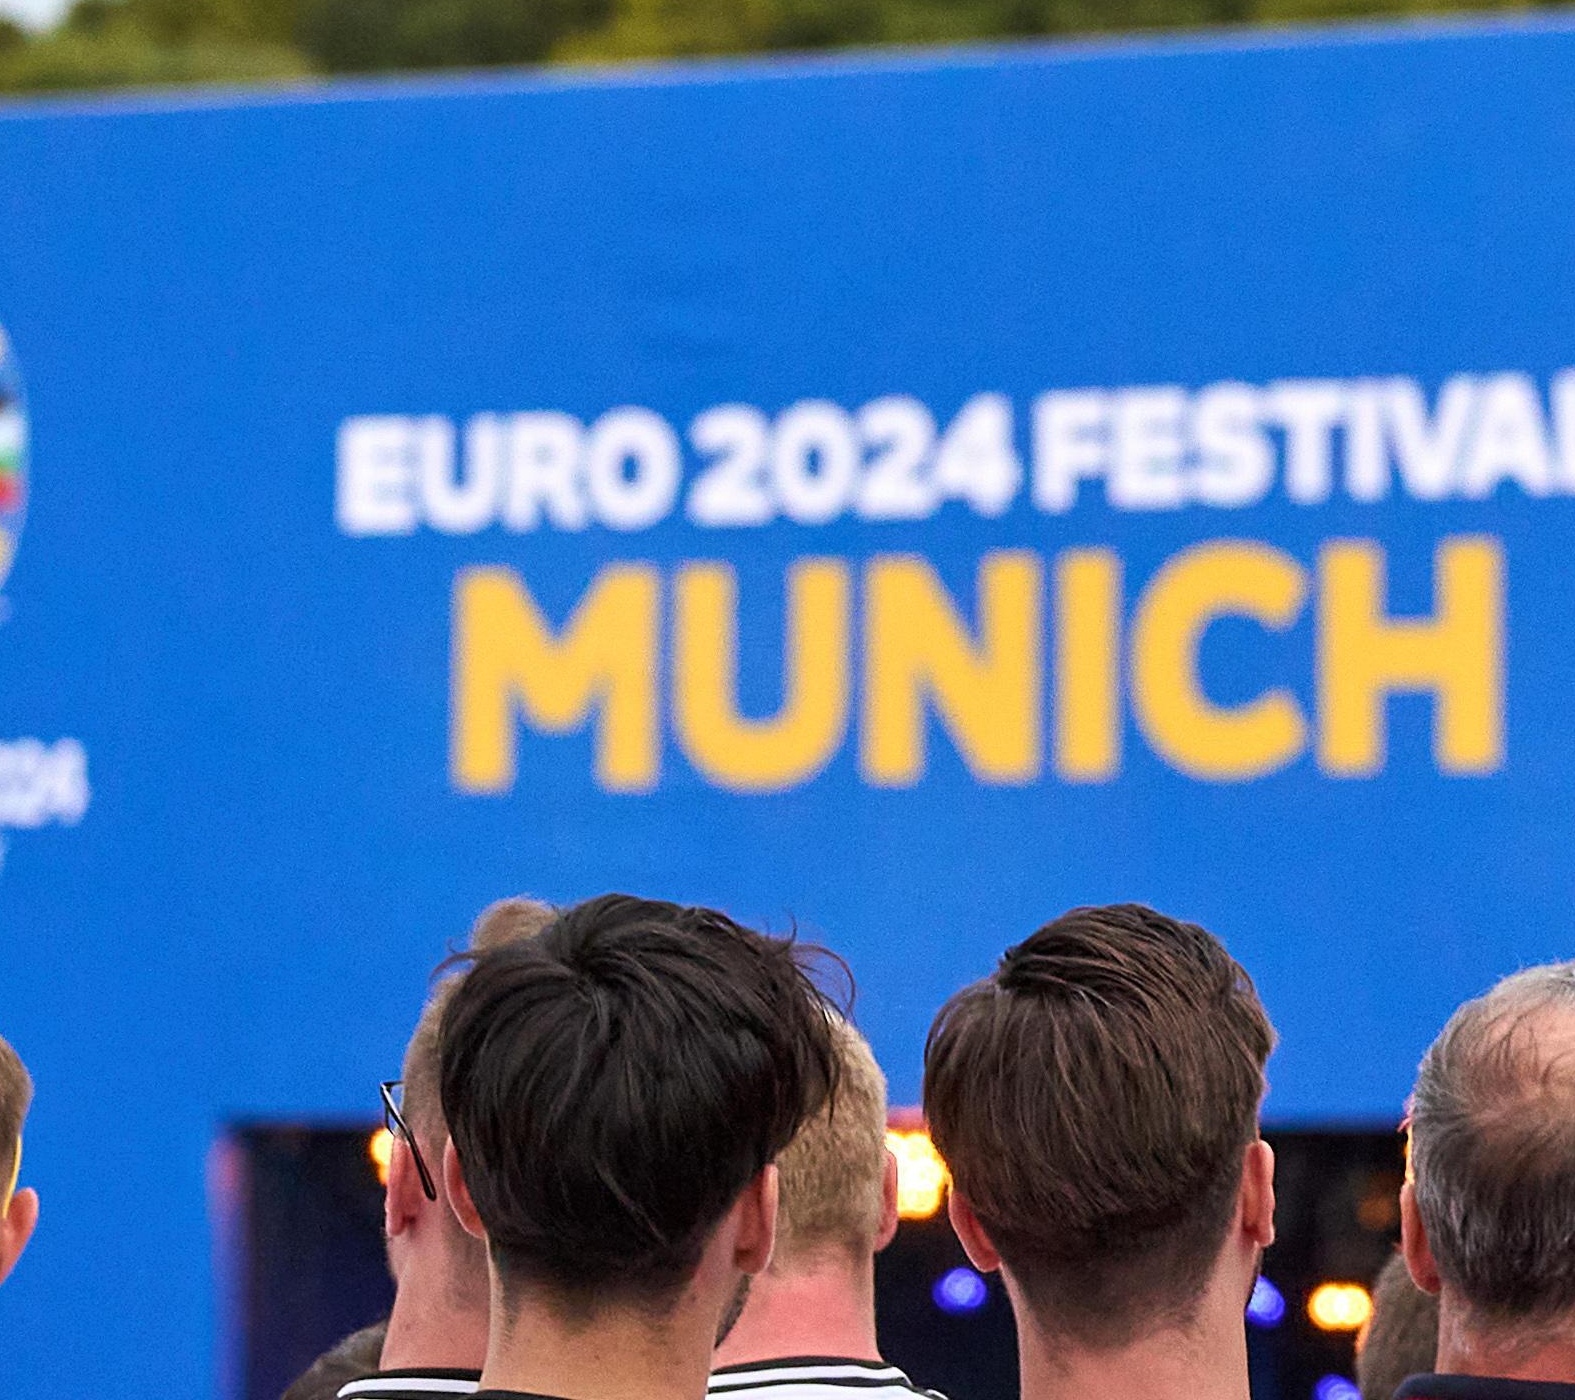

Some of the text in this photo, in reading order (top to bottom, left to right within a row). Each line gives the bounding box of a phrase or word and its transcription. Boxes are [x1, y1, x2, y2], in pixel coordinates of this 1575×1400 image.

[337, 409, 681, 534] EURO
[688, 394, 1024, 526] 2024
[449, 534, 1506, 796] MUNICH
